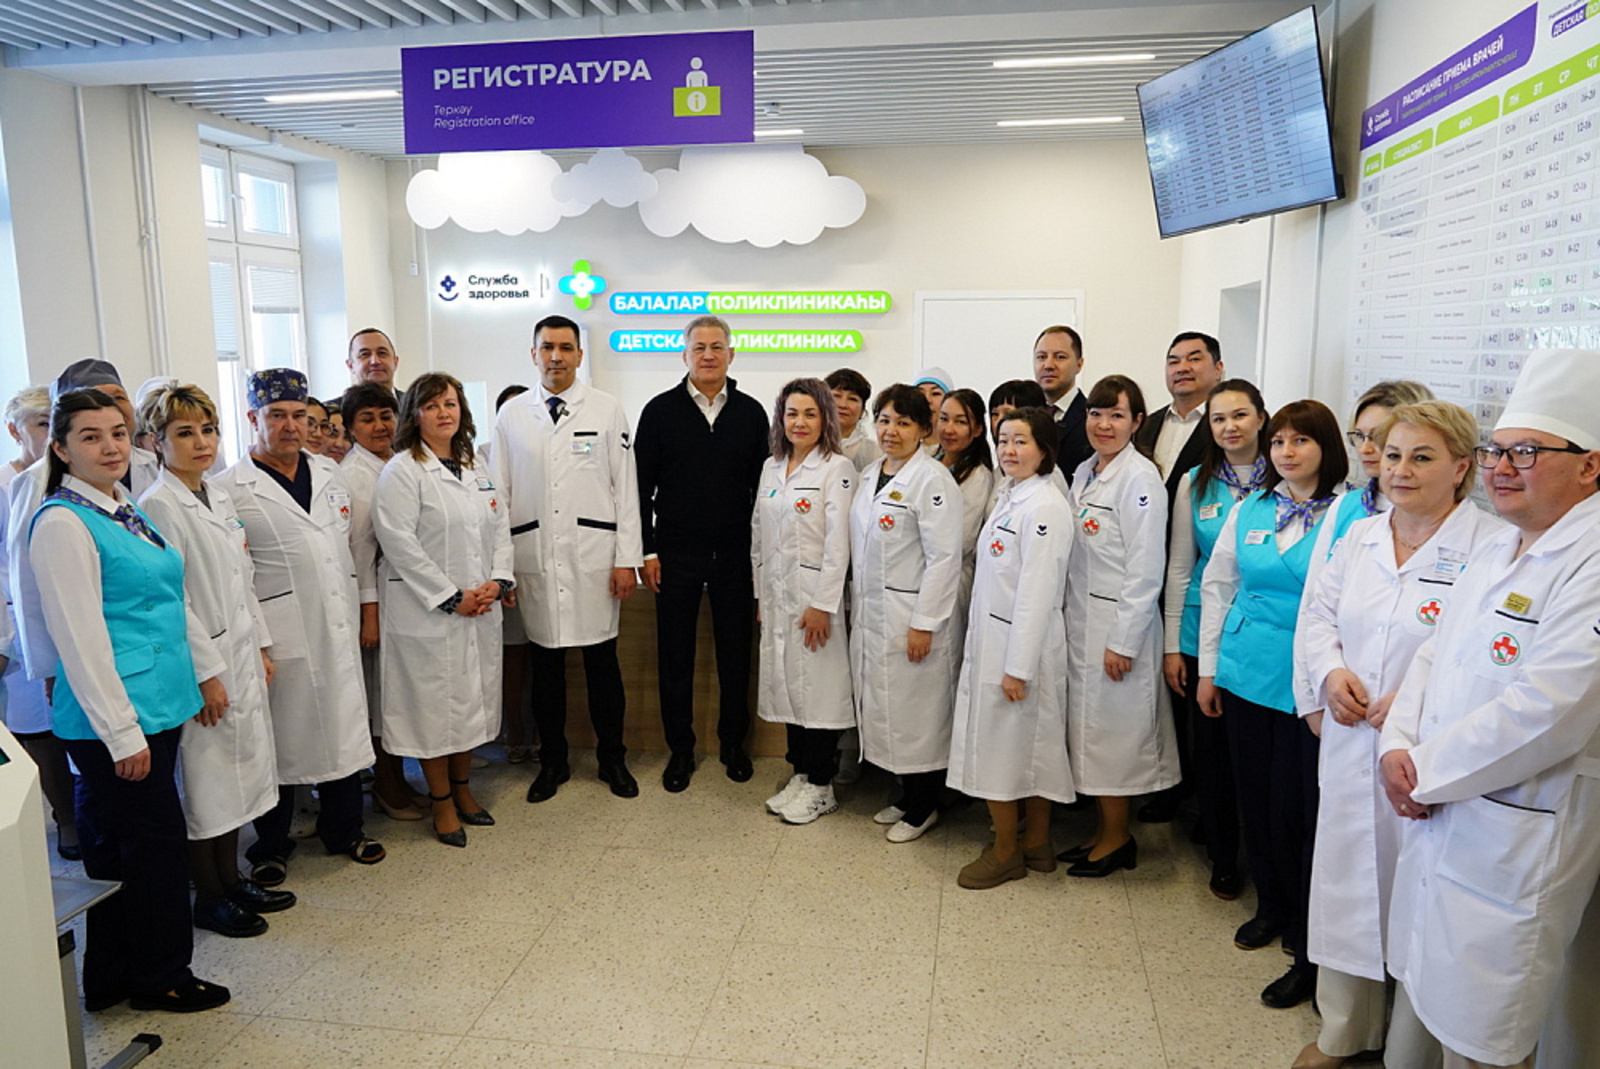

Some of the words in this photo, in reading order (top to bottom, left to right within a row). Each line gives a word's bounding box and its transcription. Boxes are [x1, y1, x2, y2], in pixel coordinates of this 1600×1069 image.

[1473, 34, 1504, 66] ВРАЧЕЙ
[433, 59, 652, 90] РЕГИСТРАТУРА
[433, 115, 501, 130] Registration
[503, 114, 535, 126] office
[468, 274, 518, 287] Служба
[468, 289, 529, 301] здоровья
[614, 295, 704, 310] БАЛАЛАР
[708, 294, 886, 310] ПОЛИКЛИНИКАҺЫ
[618, 334, 685, 350] ДЕТСКА
[729, 333, 856, 349] ЛИКЛИНИКА
